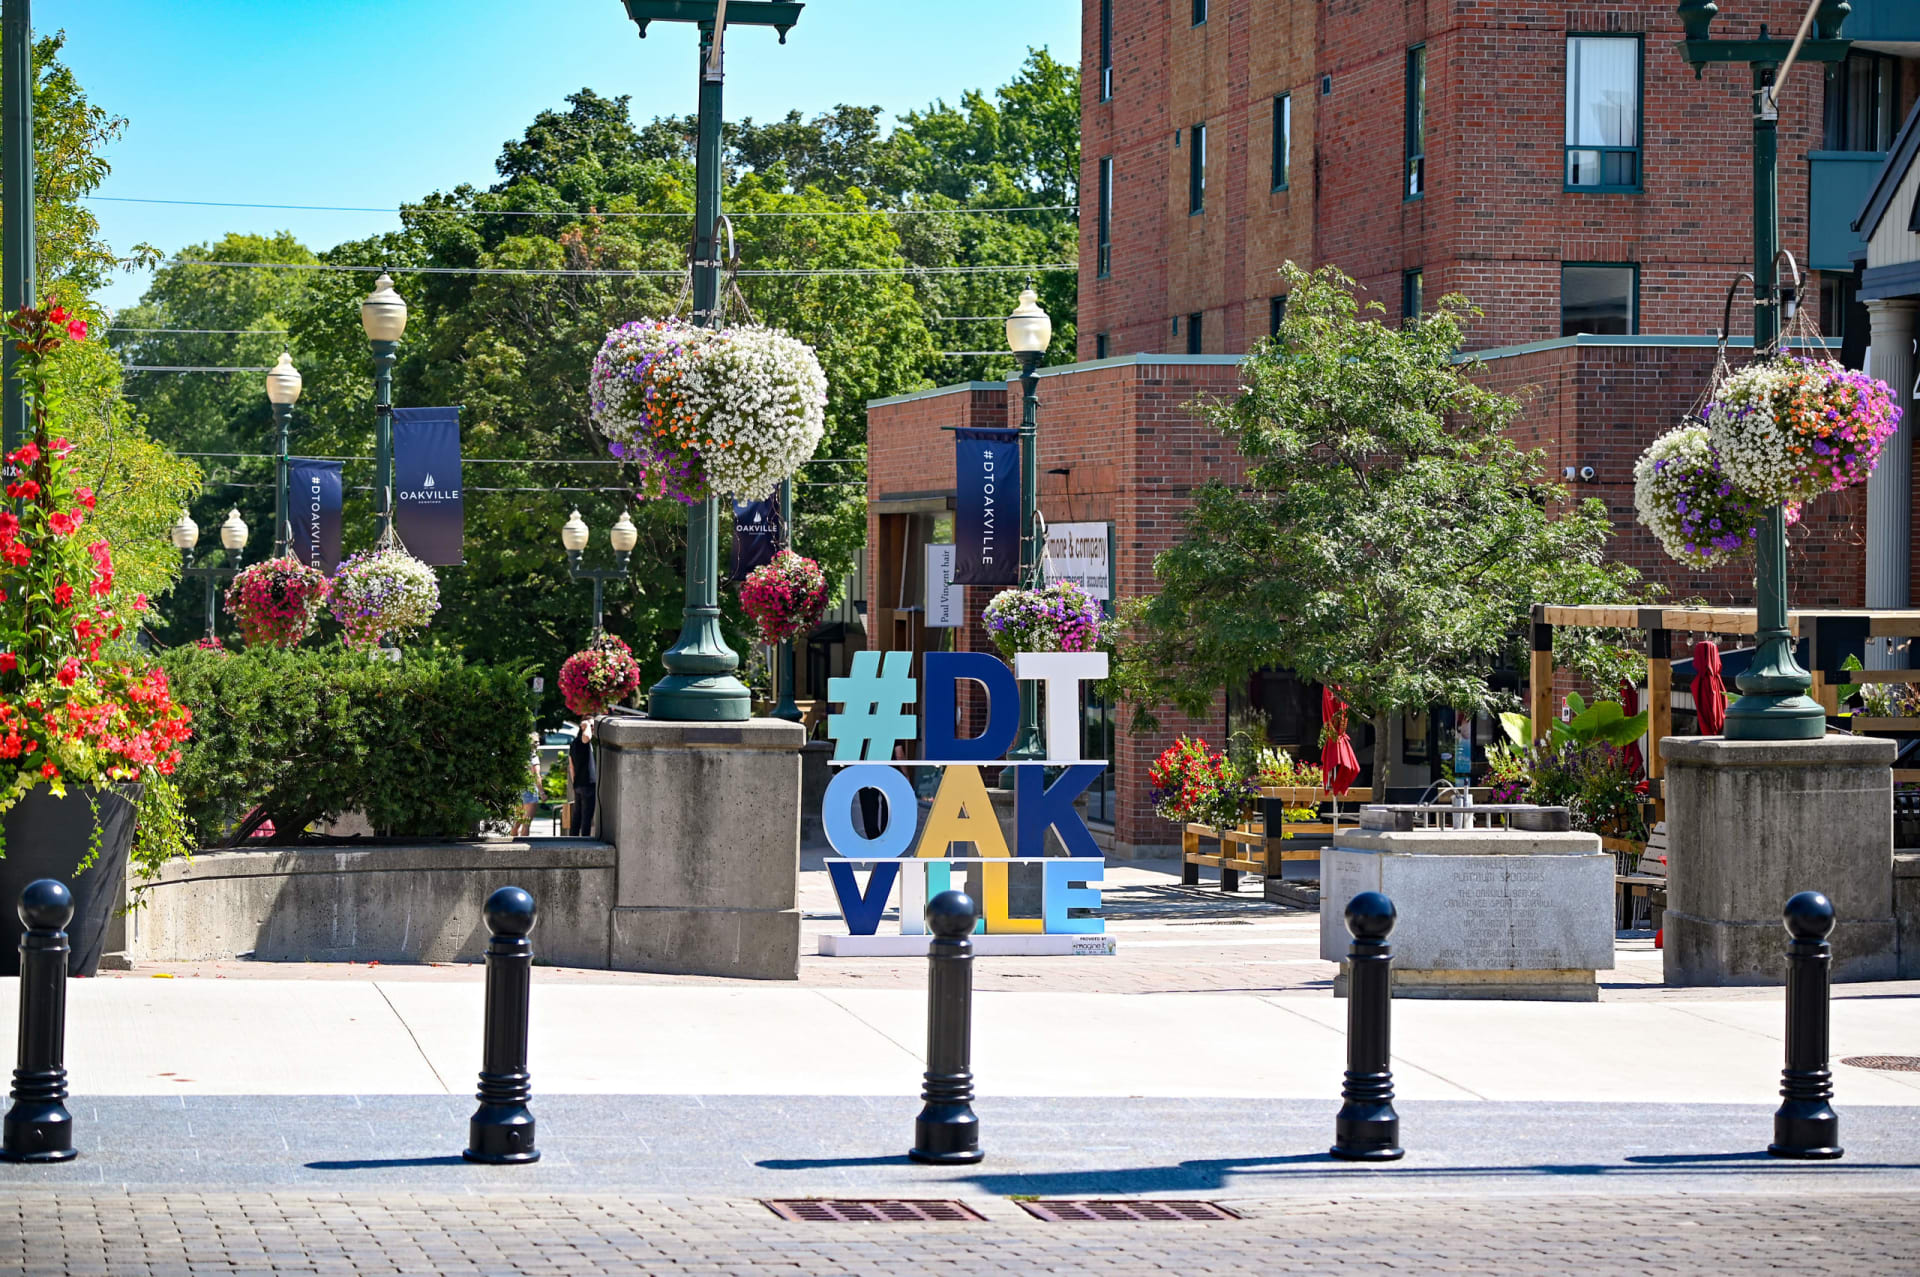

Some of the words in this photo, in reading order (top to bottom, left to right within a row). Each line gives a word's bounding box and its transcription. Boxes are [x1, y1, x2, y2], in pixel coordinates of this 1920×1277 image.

[400, 491, 459, 500] OAKVILLE
[983, 450, 994, 564] #DTOAKVILLE
[311, 476, 321, 567] #DTOAKVILLE
[941, 550, 949, 567] hair
[1076, 537, 1107, 566] company
[941, 570, 949, 603] Vincent
[941, 605, 949, 622] Paul
[827, 651, 1108, 761] #DT
[822, 764, 1107, 858] OAK
